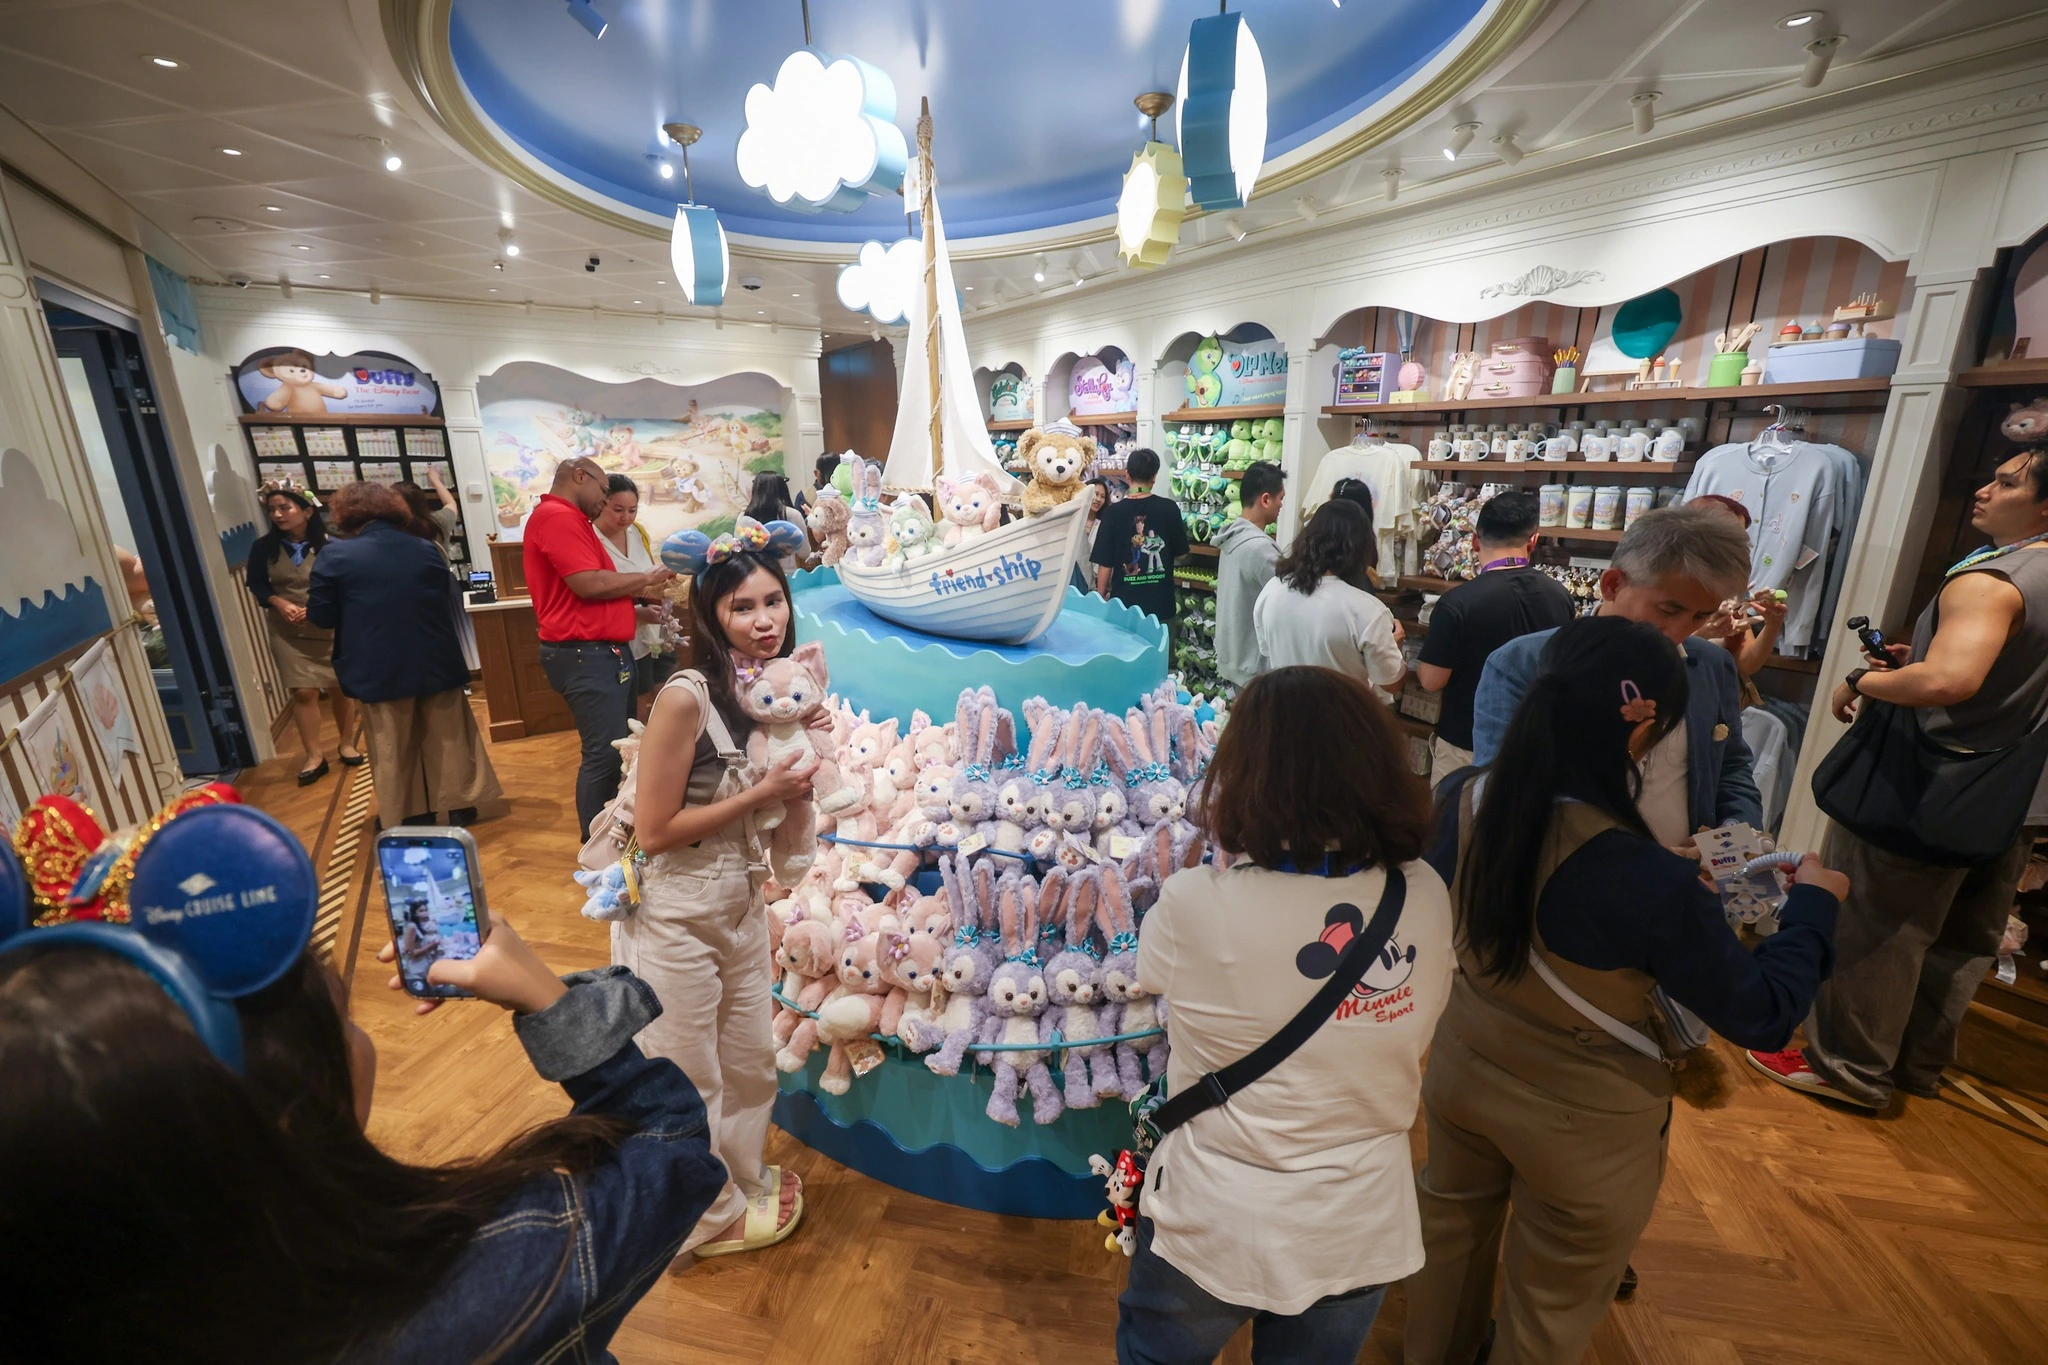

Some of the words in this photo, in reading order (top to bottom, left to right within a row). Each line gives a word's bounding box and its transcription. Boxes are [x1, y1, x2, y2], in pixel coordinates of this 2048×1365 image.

[353, 367, 415, 386] Duffy
[370, 384, 401, 397] Disney
[1711, 856, 1737, 867] Duffy
[141, 905, 184, 925] Disney
[184, 892, 236, 918] CRUISE
[240, 885, 277, 908] LINE
[1336, 985, 1413, 1021] Minnie
[1374, 1001, 1415, 1023] Sport
